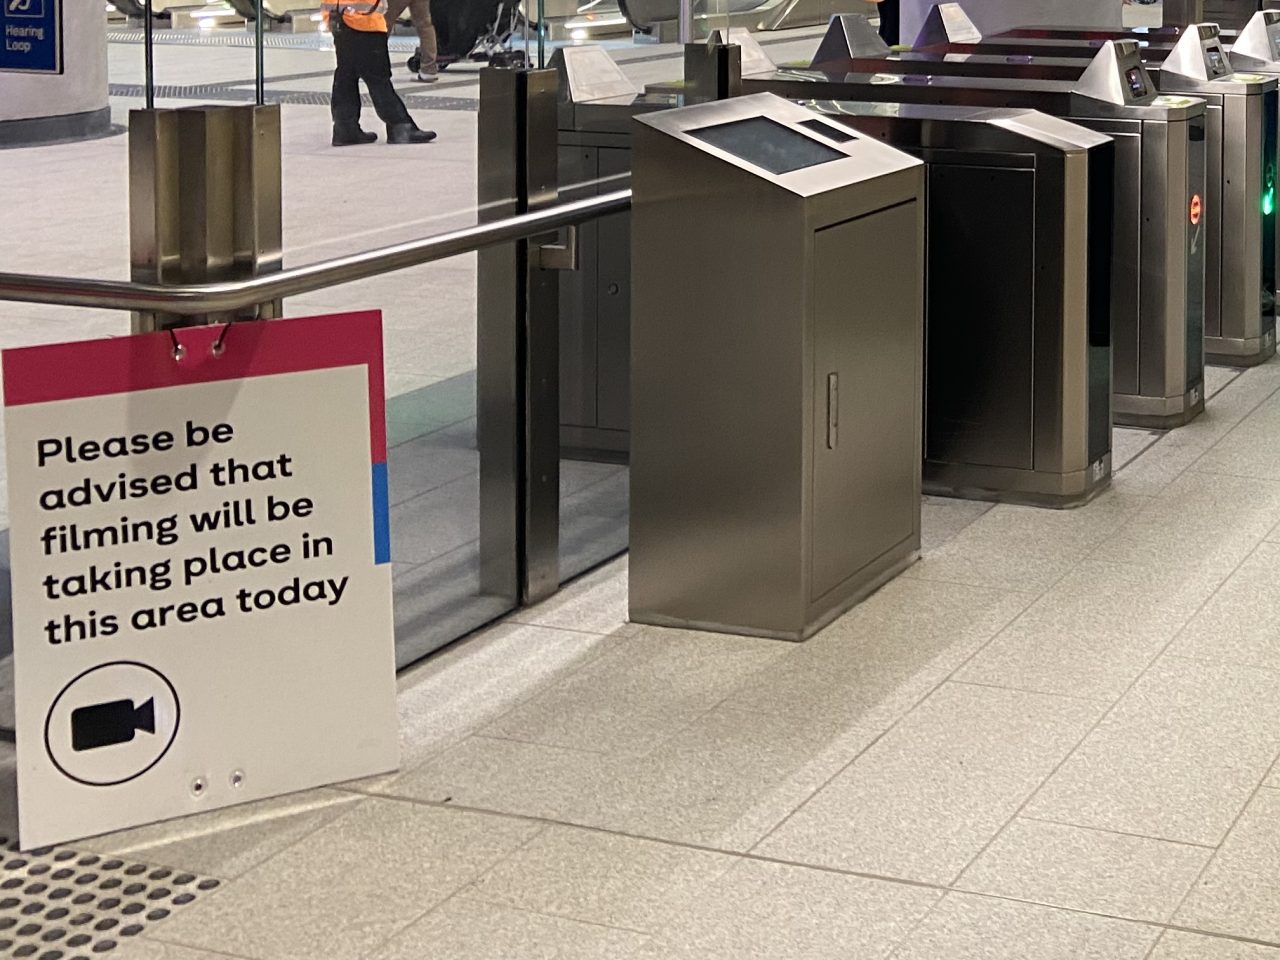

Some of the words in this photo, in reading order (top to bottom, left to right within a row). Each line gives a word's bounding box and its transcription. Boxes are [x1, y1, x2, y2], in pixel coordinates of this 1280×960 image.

[5, 25, 45, 40] Hearing
[5, 39, 32, 53] Loop
[37, 430, 174, 467] Please
[185, 421, 234, 447] be
[39, 464, 198, 511] advised
[209, 454, 293, 487] that
[40, 513, 178, 556] filming
[190, 498, 256, 532] will
[267, 495, 314, 522] be
[43, 558, 172, 600] taking
[184, 543, 291, 585] place
[302, 533, 333, 559] in
[44, 610, 119, 645] this
[131, 596, 225, 630] area
[236, 576, 349, 613] today
